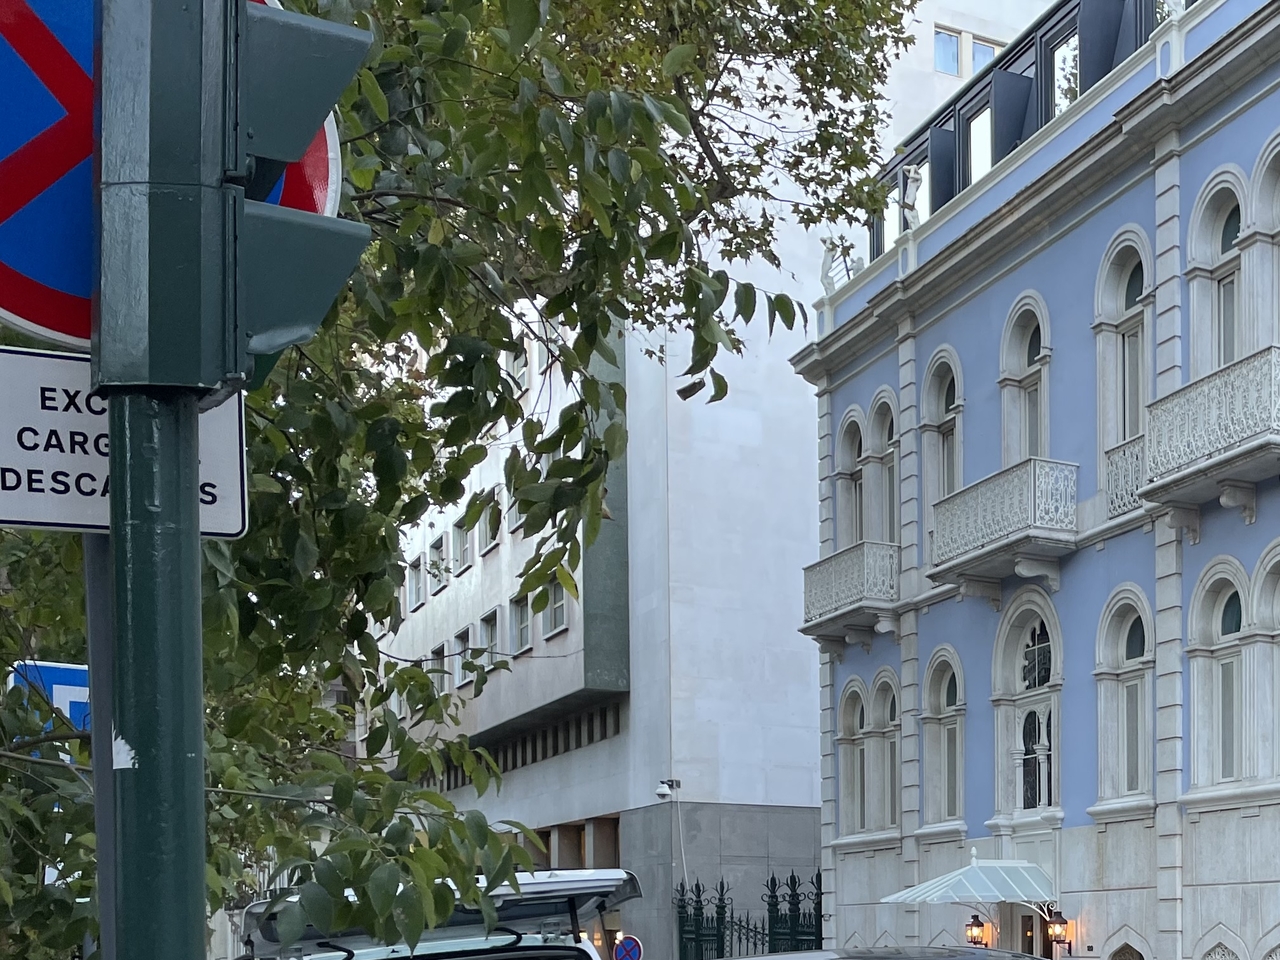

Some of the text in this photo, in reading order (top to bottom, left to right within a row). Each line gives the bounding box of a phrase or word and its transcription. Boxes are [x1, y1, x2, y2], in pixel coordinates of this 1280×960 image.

[40, 386, 108, 416] EXC
[16, 426, 110, 458] CARG
[0, 467, 218, 505] DESCS
